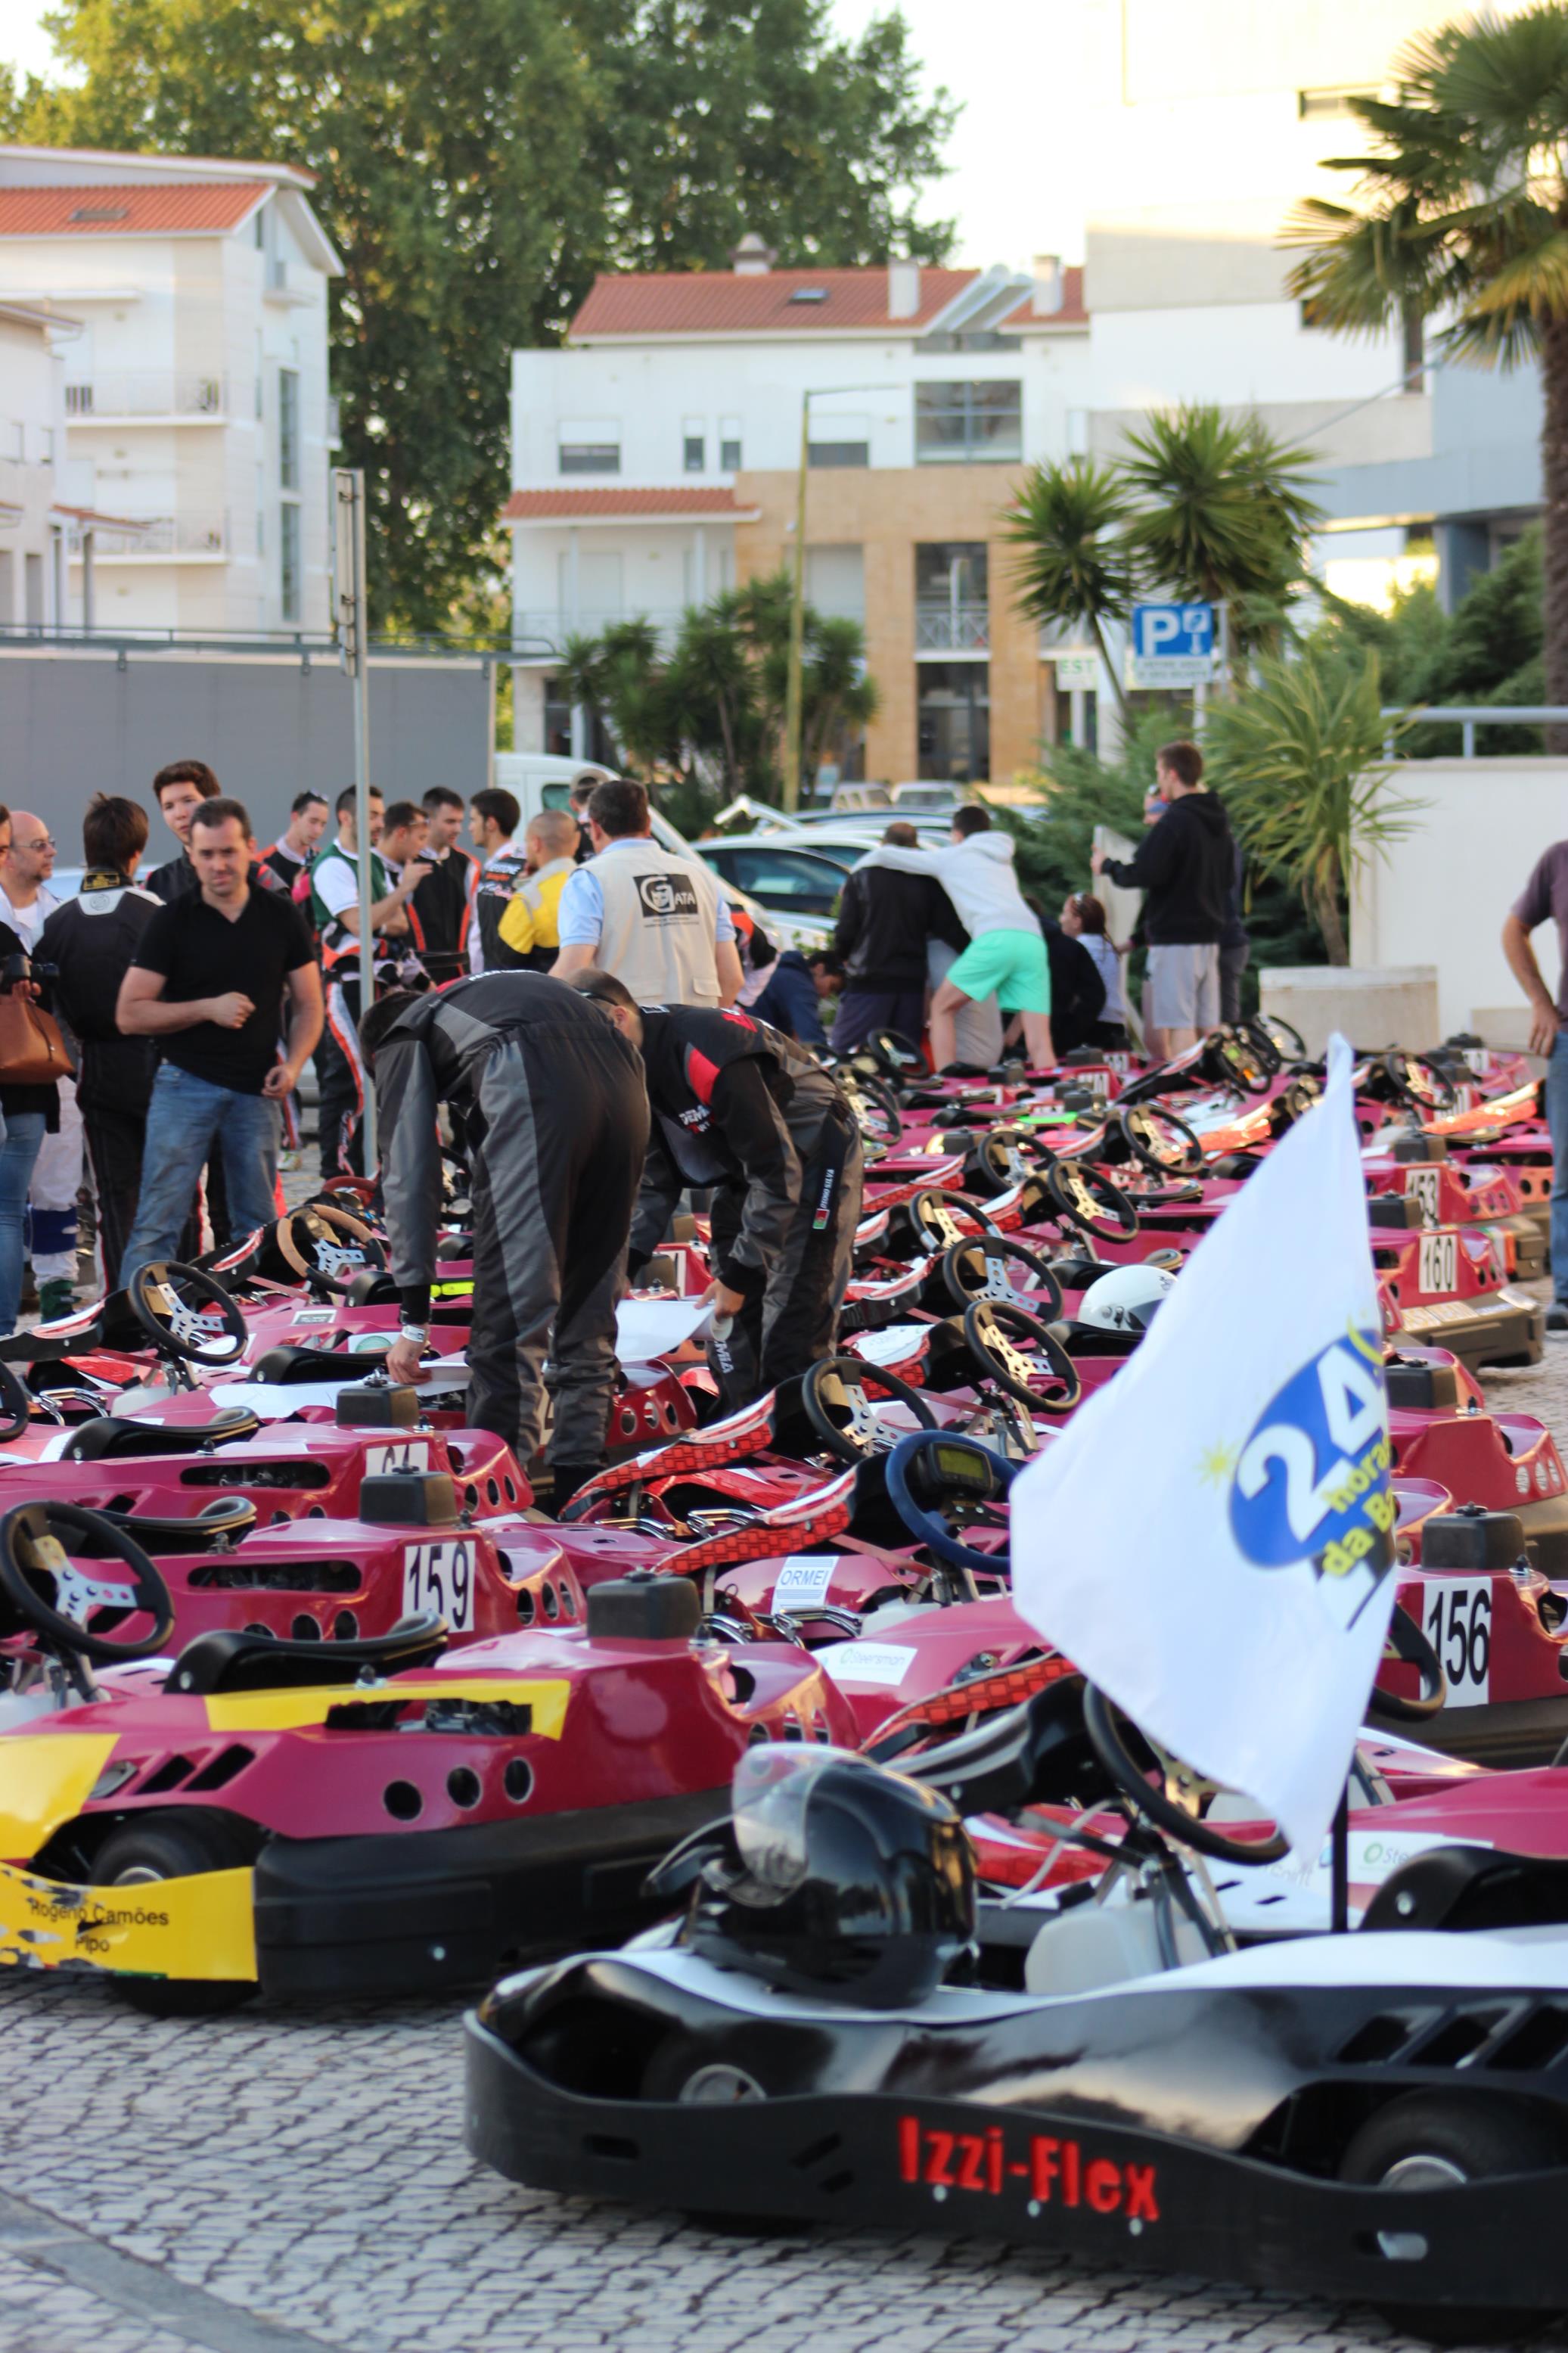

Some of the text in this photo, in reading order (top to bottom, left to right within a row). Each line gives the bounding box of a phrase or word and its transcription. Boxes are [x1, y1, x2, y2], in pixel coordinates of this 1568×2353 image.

[1141, 610, 1180, 657] P
[1424, 1236, 1454, 1292] 160
[1237, 1344, 1389, 1543] 24
[1322, 1438, 1390, 1515] hora
[408, 1540, 469, 1630] 159
[1322, 1525, 1376, 1577] da
[1427, 1588, 1492, 1686] 156
[93, 1904, 170, 1926] Camões
[898, 2115, 1160, 2223] Izzi-Flex
